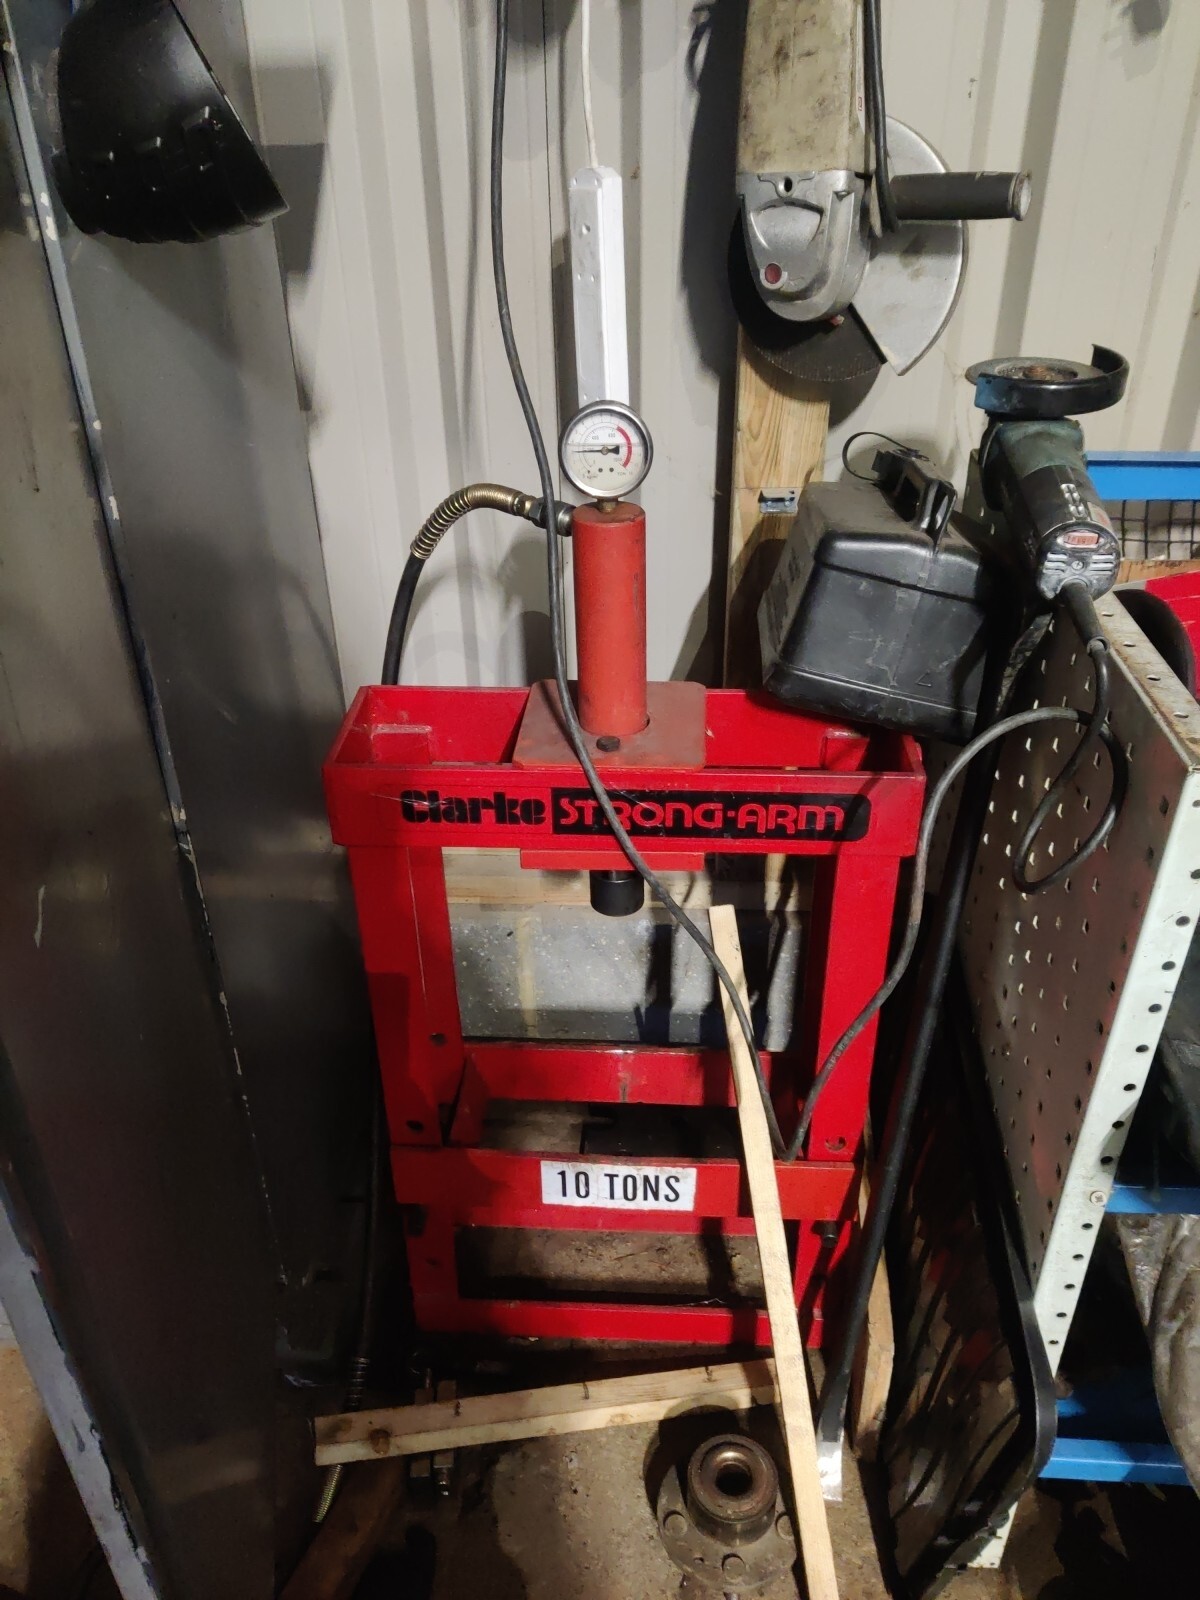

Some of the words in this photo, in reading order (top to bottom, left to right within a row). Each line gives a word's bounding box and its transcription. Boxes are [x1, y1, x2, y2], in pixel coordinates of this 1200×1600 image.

[400, 789, 546, 825] Clarke
[557, 1170, 590, 1198] 10
[604, 1173, 680, 1202] TONS
